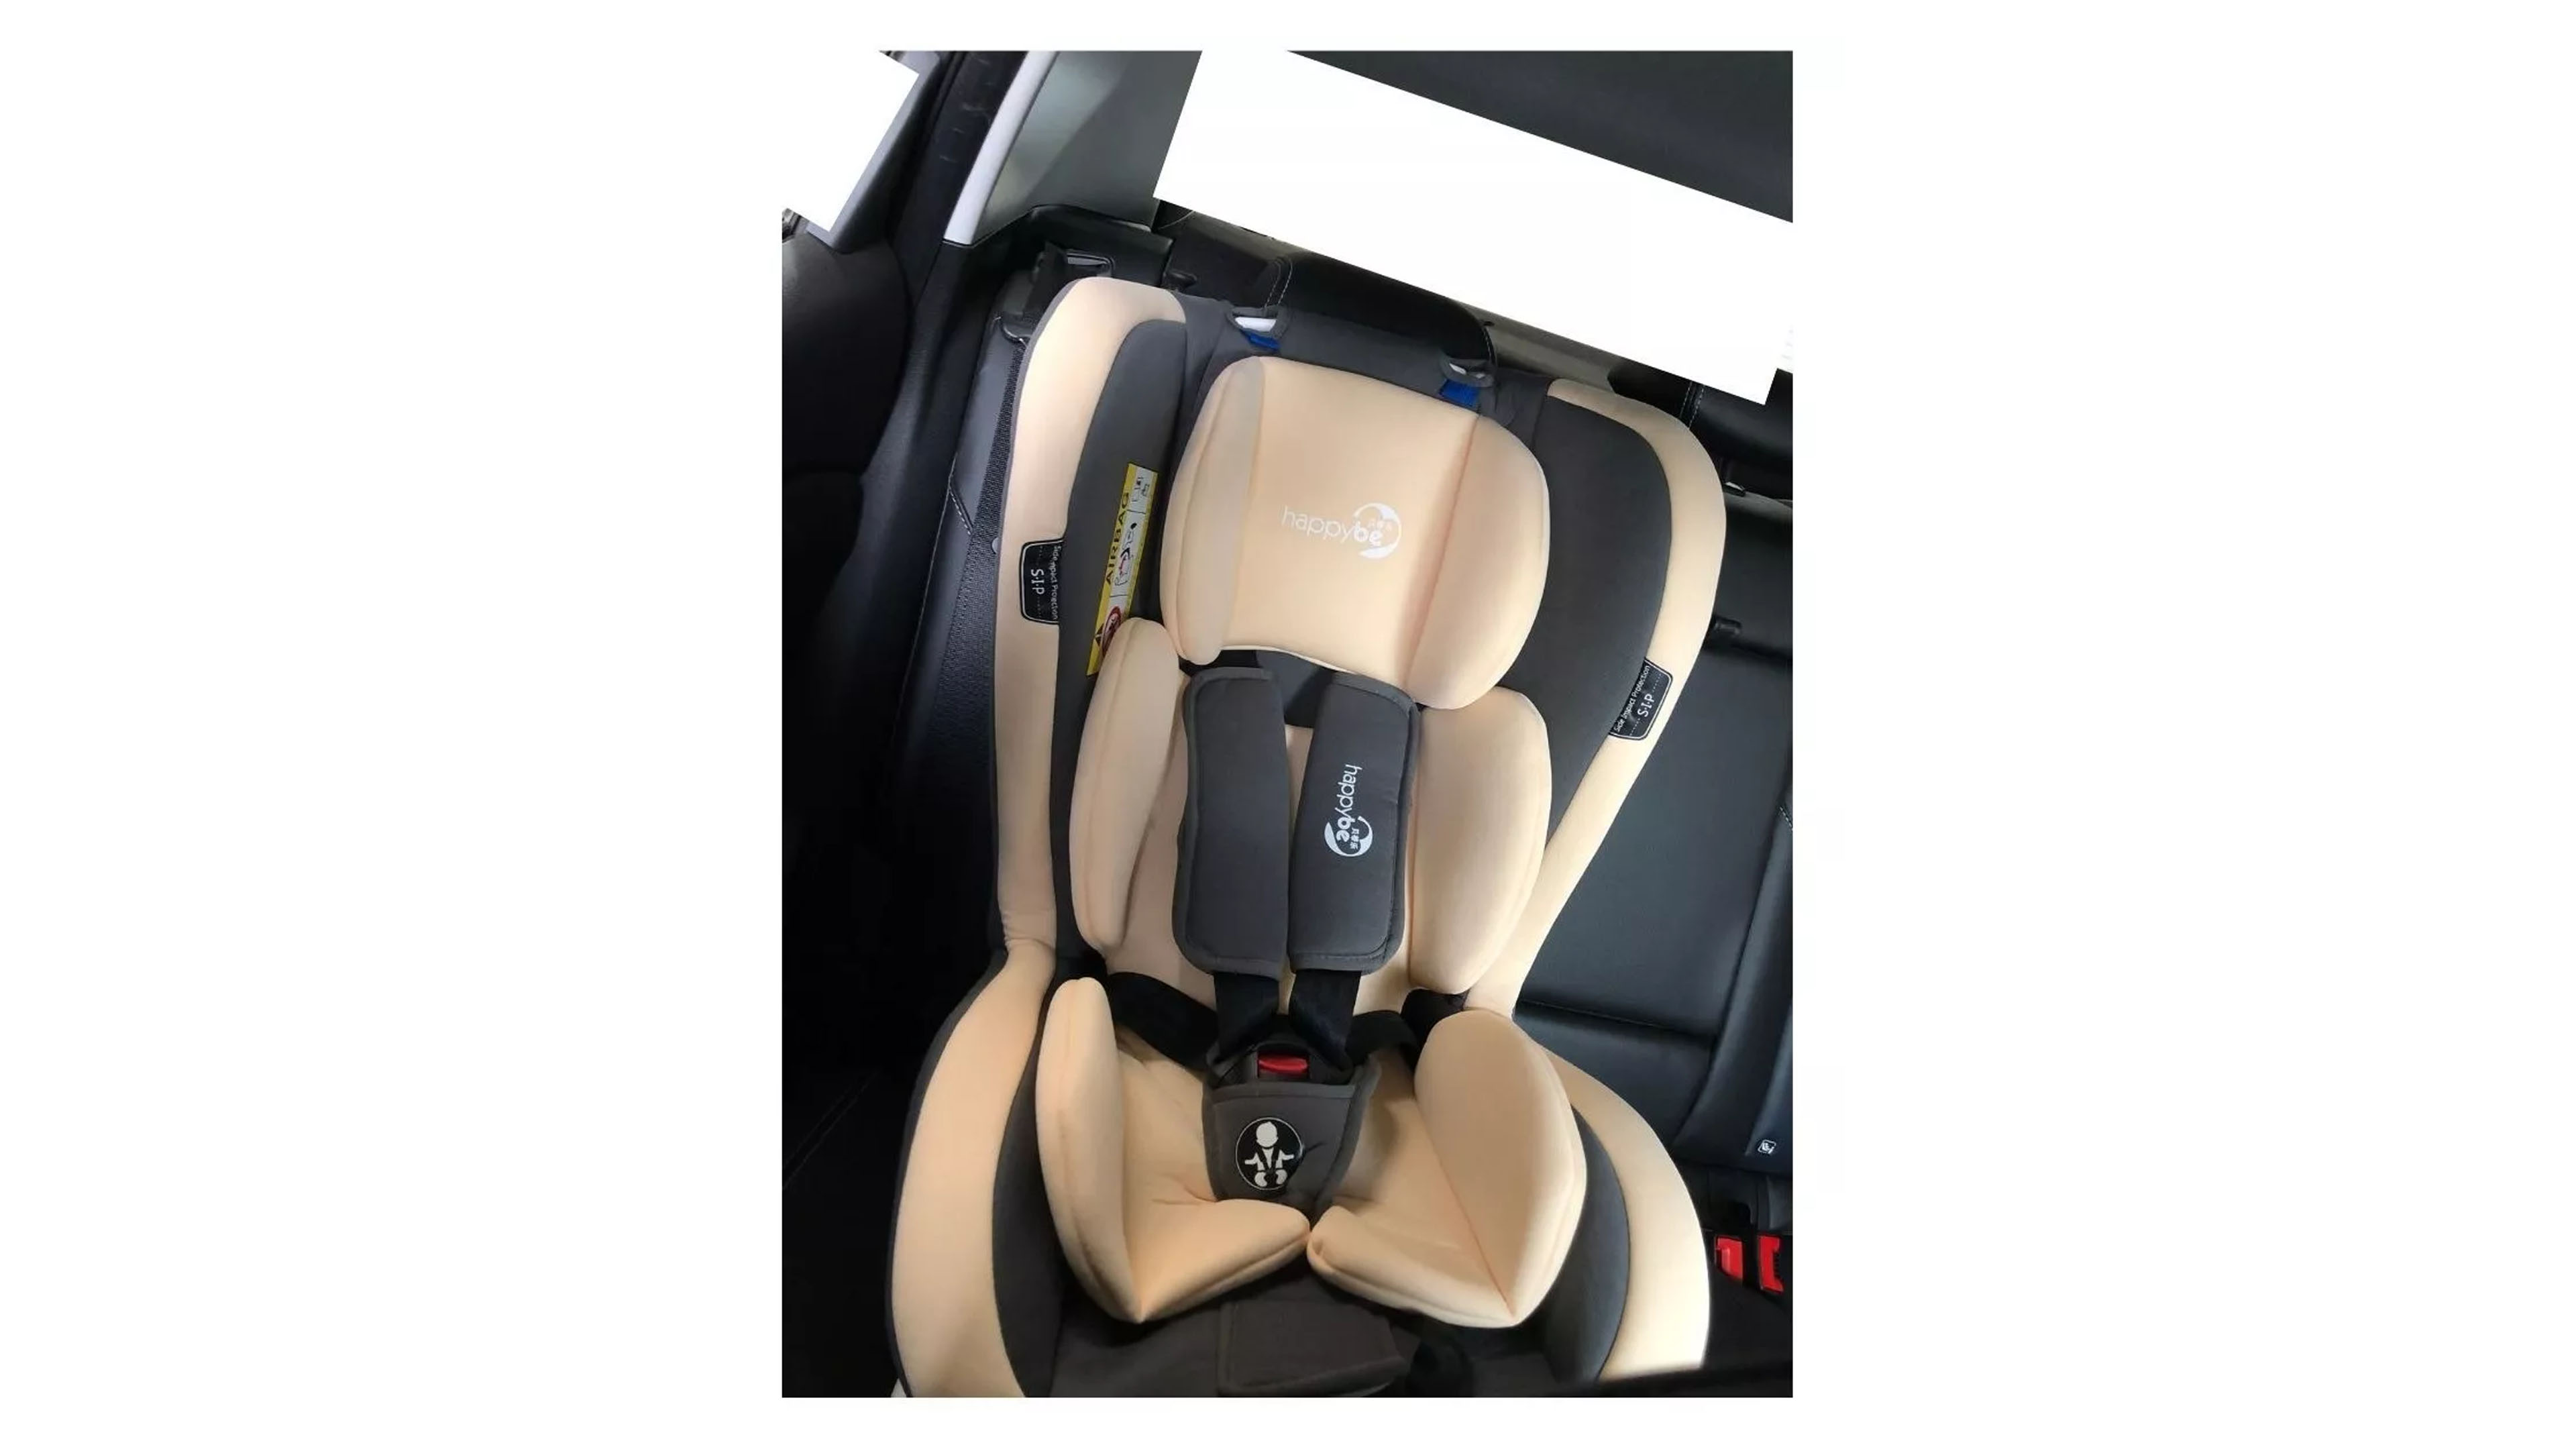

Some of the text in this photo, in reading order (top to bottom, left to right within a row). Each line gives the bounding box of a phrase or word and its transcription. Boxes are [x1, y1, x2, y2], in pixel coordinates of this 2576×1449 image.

[1107, 493, 1129, 584] AIRBAG
[1281, 504, 1383, 547] happybe
[1631, 665, 1650, 698] Protection
[1334, 764, 1362, 843] happybe
